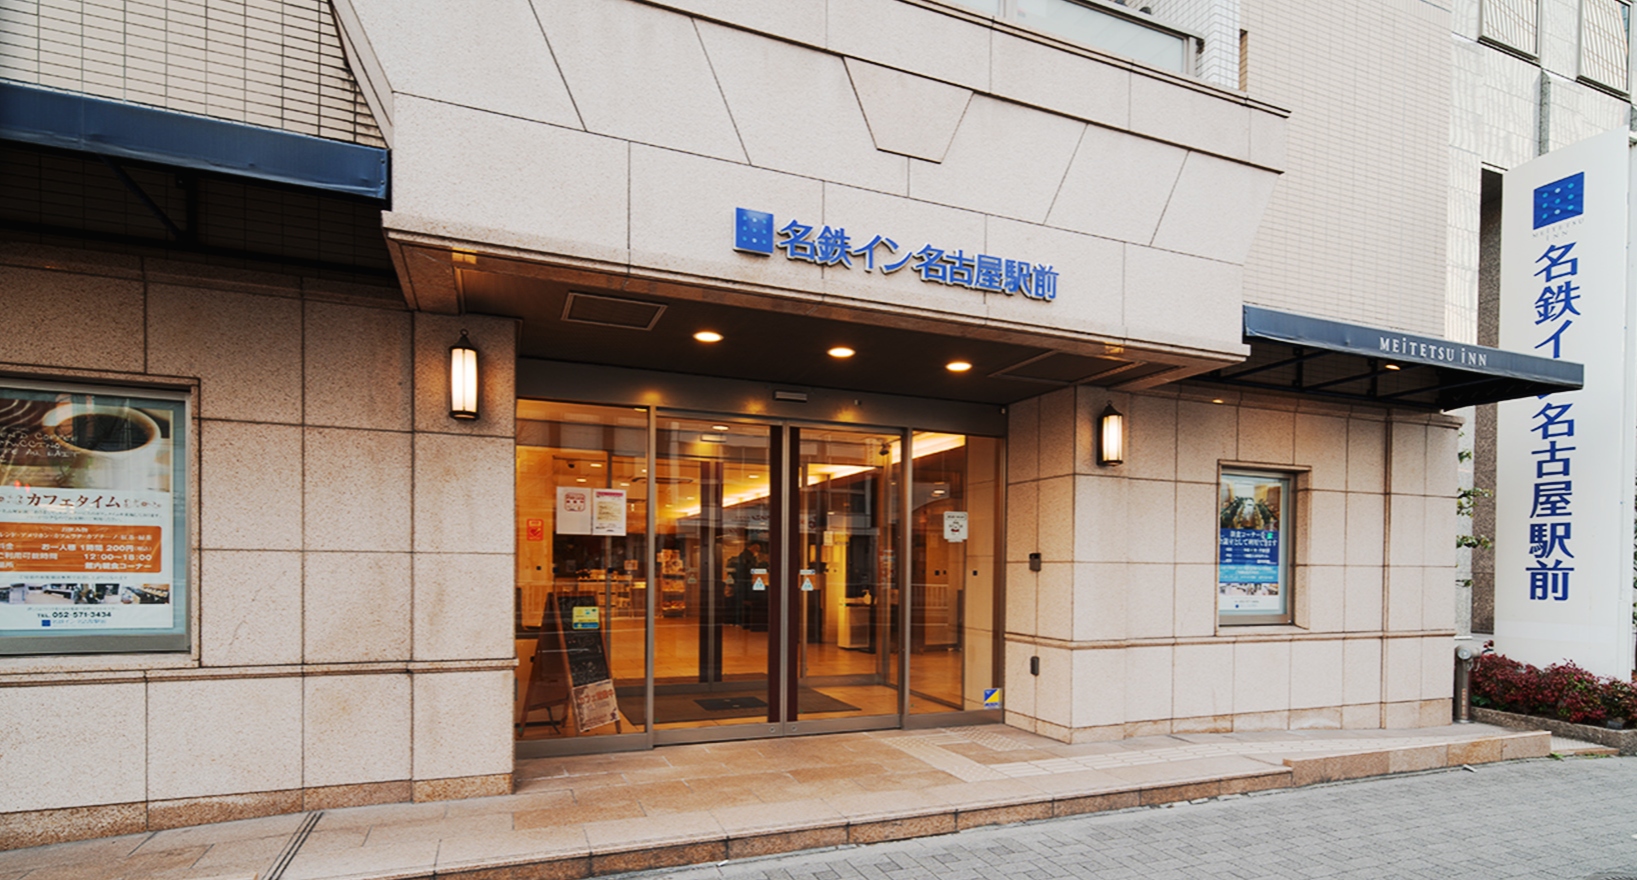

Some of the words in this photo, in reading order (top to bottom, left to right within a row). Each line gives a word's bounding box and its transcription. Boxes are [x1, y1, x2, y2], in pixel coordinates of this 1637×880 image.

[778, 219, 1060, 301] 名鉄イン名古屋駅前
[1525, 242, 1581, 601] 名鉄イ名古屋駅前
[27, 492, 121, 509] カフェタイム
